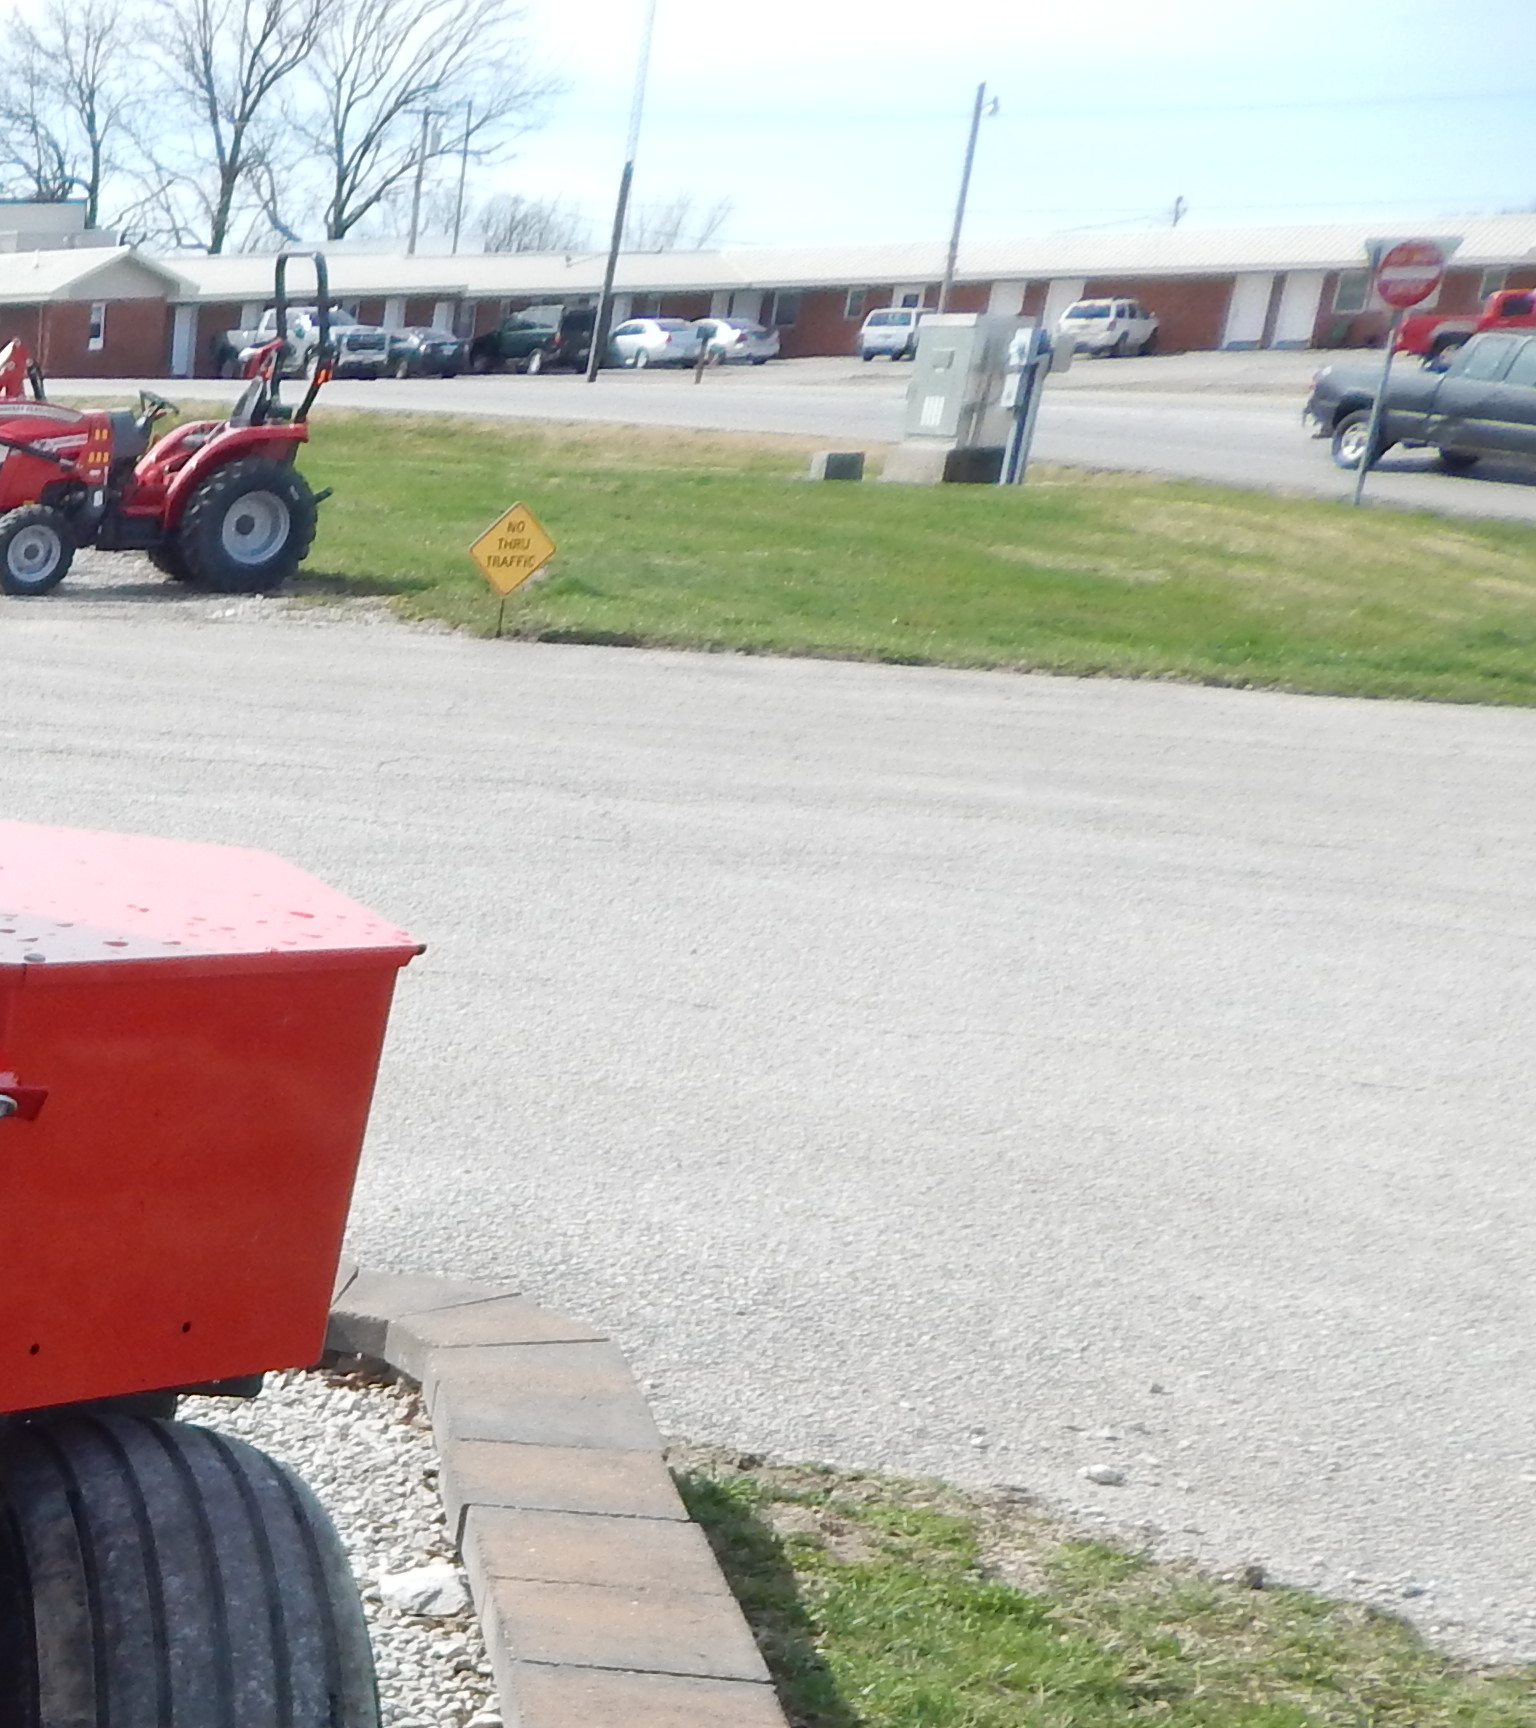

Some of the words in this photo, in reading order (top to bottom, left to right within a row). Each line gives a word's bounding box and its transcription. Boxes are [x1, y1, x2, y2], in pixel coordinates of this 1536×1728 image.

[506, 521, 525, 533] NO
[498, 538, 531, 550] THRU
[486, 555, 536, 568] TRAFFIC
